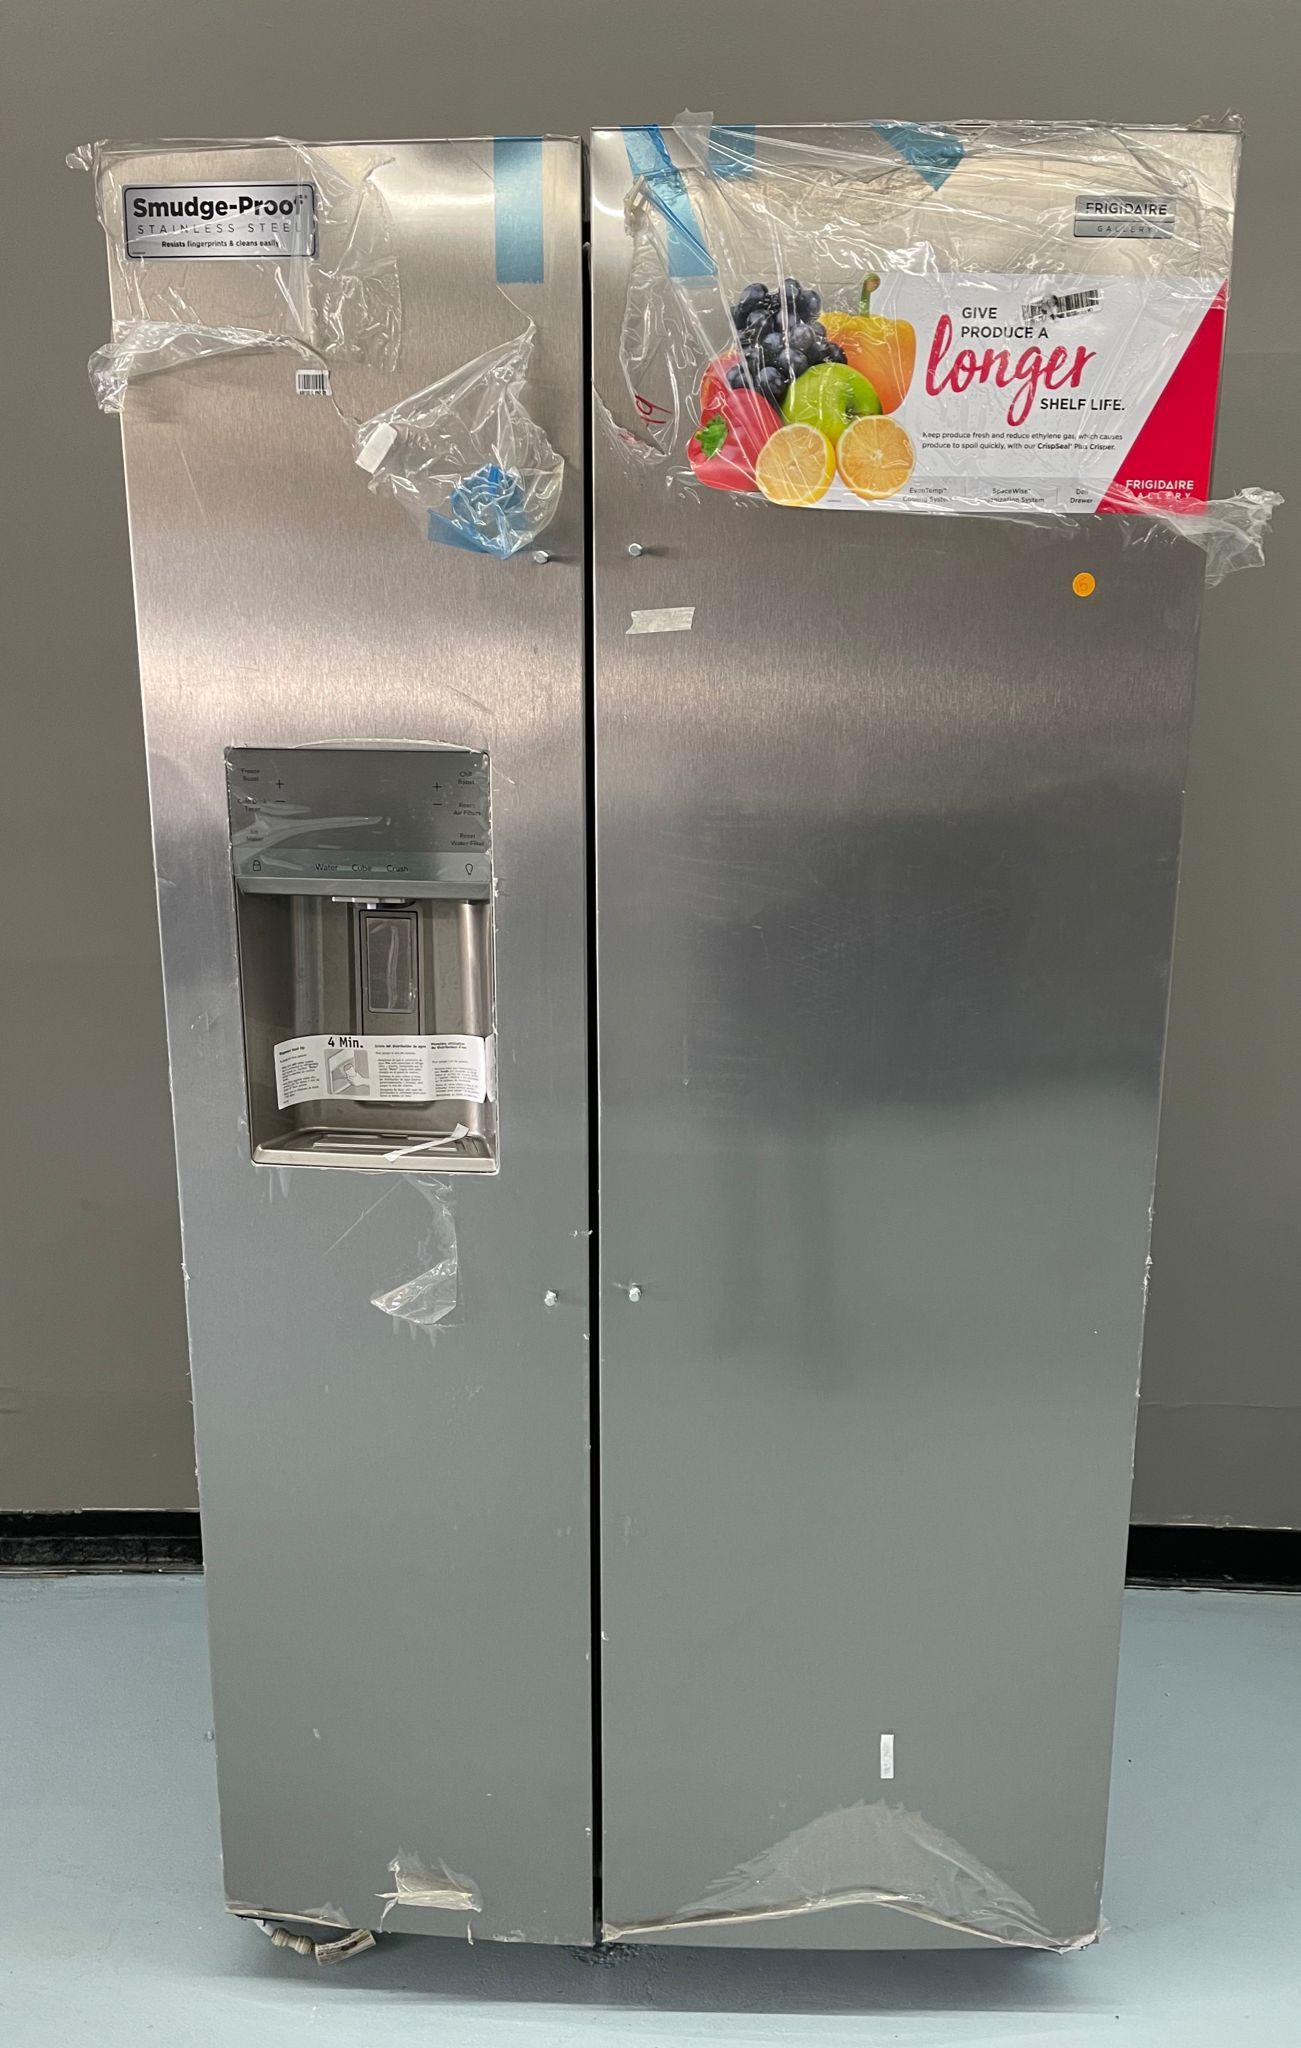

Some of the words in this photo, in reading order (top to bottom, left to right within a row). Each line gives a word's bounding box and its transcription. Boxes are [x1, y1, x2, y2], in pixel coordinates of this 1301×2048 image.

[1086, 202, 1168, 215] FRIGIDAIRE
[138, 223, 235, 235] STAINLESS
[247, 222, 302, 233] STEEL
[187, 240, 228, 249] fingerprints
[259, 240, 279, 248] easily
[962, 307, 998, 319] GIVE
[961, 327, 1033, 339] PRODUCE
[1038, 327, 1049, 339] A
[925, 313, 1097, 426] longer
[1040, 398, 1086, 410] SHELF
[1090, 399, 1125, 411] LIFE.
[942, 432, 971, 440] produce
[972, 431, 990, 439] fresh
[922, 442, 951, 450] produce
[1126, 479, 1195, 490] FRIGIDAIRE
[1127, 492, 1192, 500] ALLERY
[315, 863, 338, 872] Water
[351, 863, 372, 872] Cube
[386, 864, 409, 873] Crush
[327, 1036, 335, 1048] 4
[339, 1036, 364, 1049] Min.
